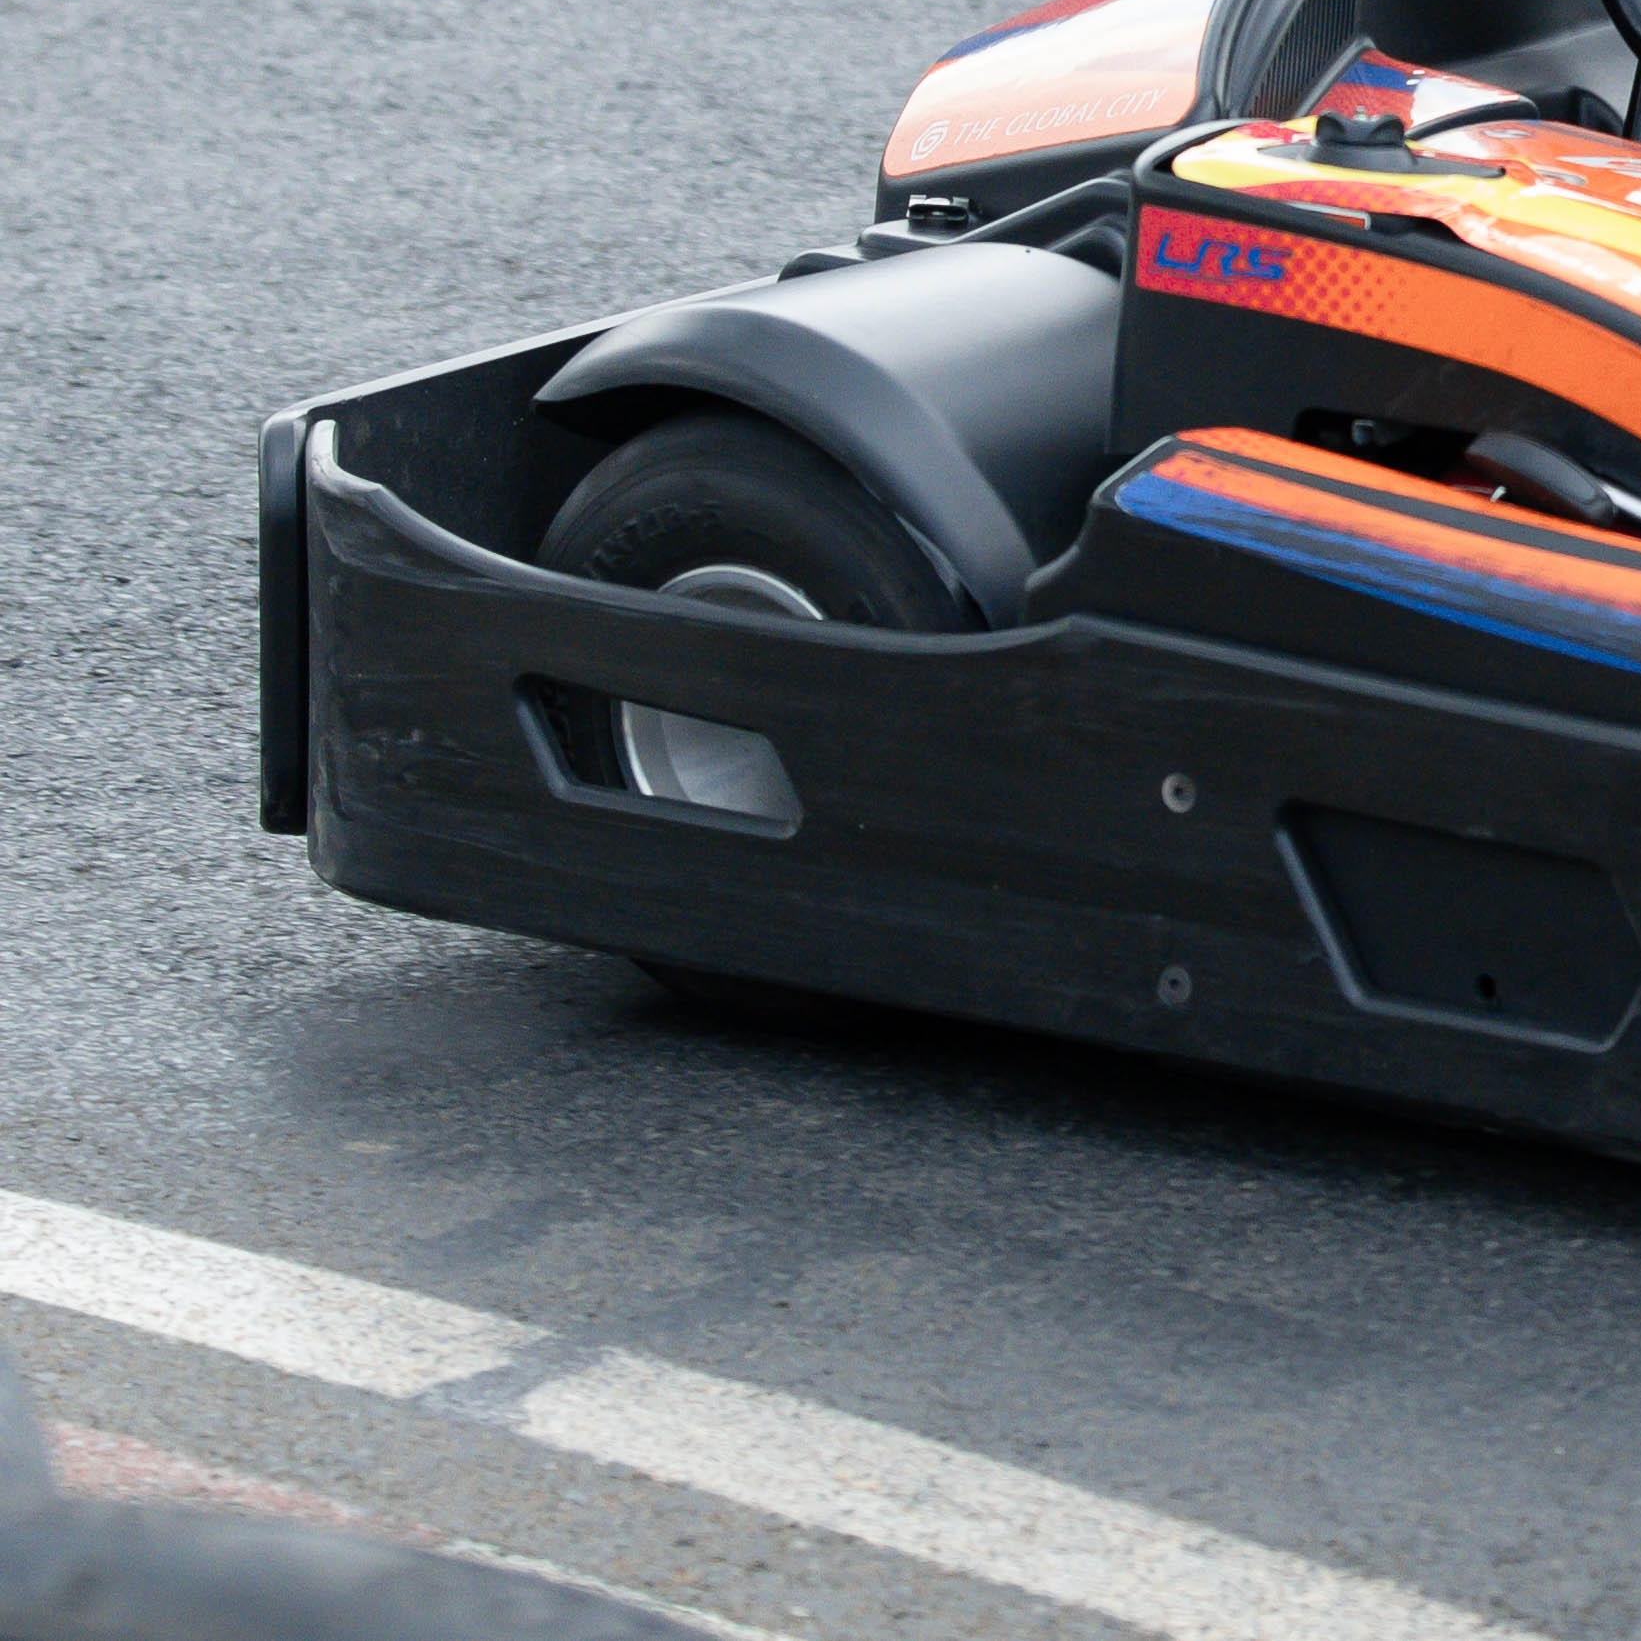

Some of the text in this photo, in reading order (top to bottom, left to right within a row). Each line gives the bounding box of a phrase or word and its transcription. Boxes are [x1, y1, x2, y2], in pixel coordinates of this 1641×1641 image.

[953, 116, 1005, 145] THE
[1005, 100, 1102, 136] GLOBAL
[1106, 87, 1168, 119] CITY
